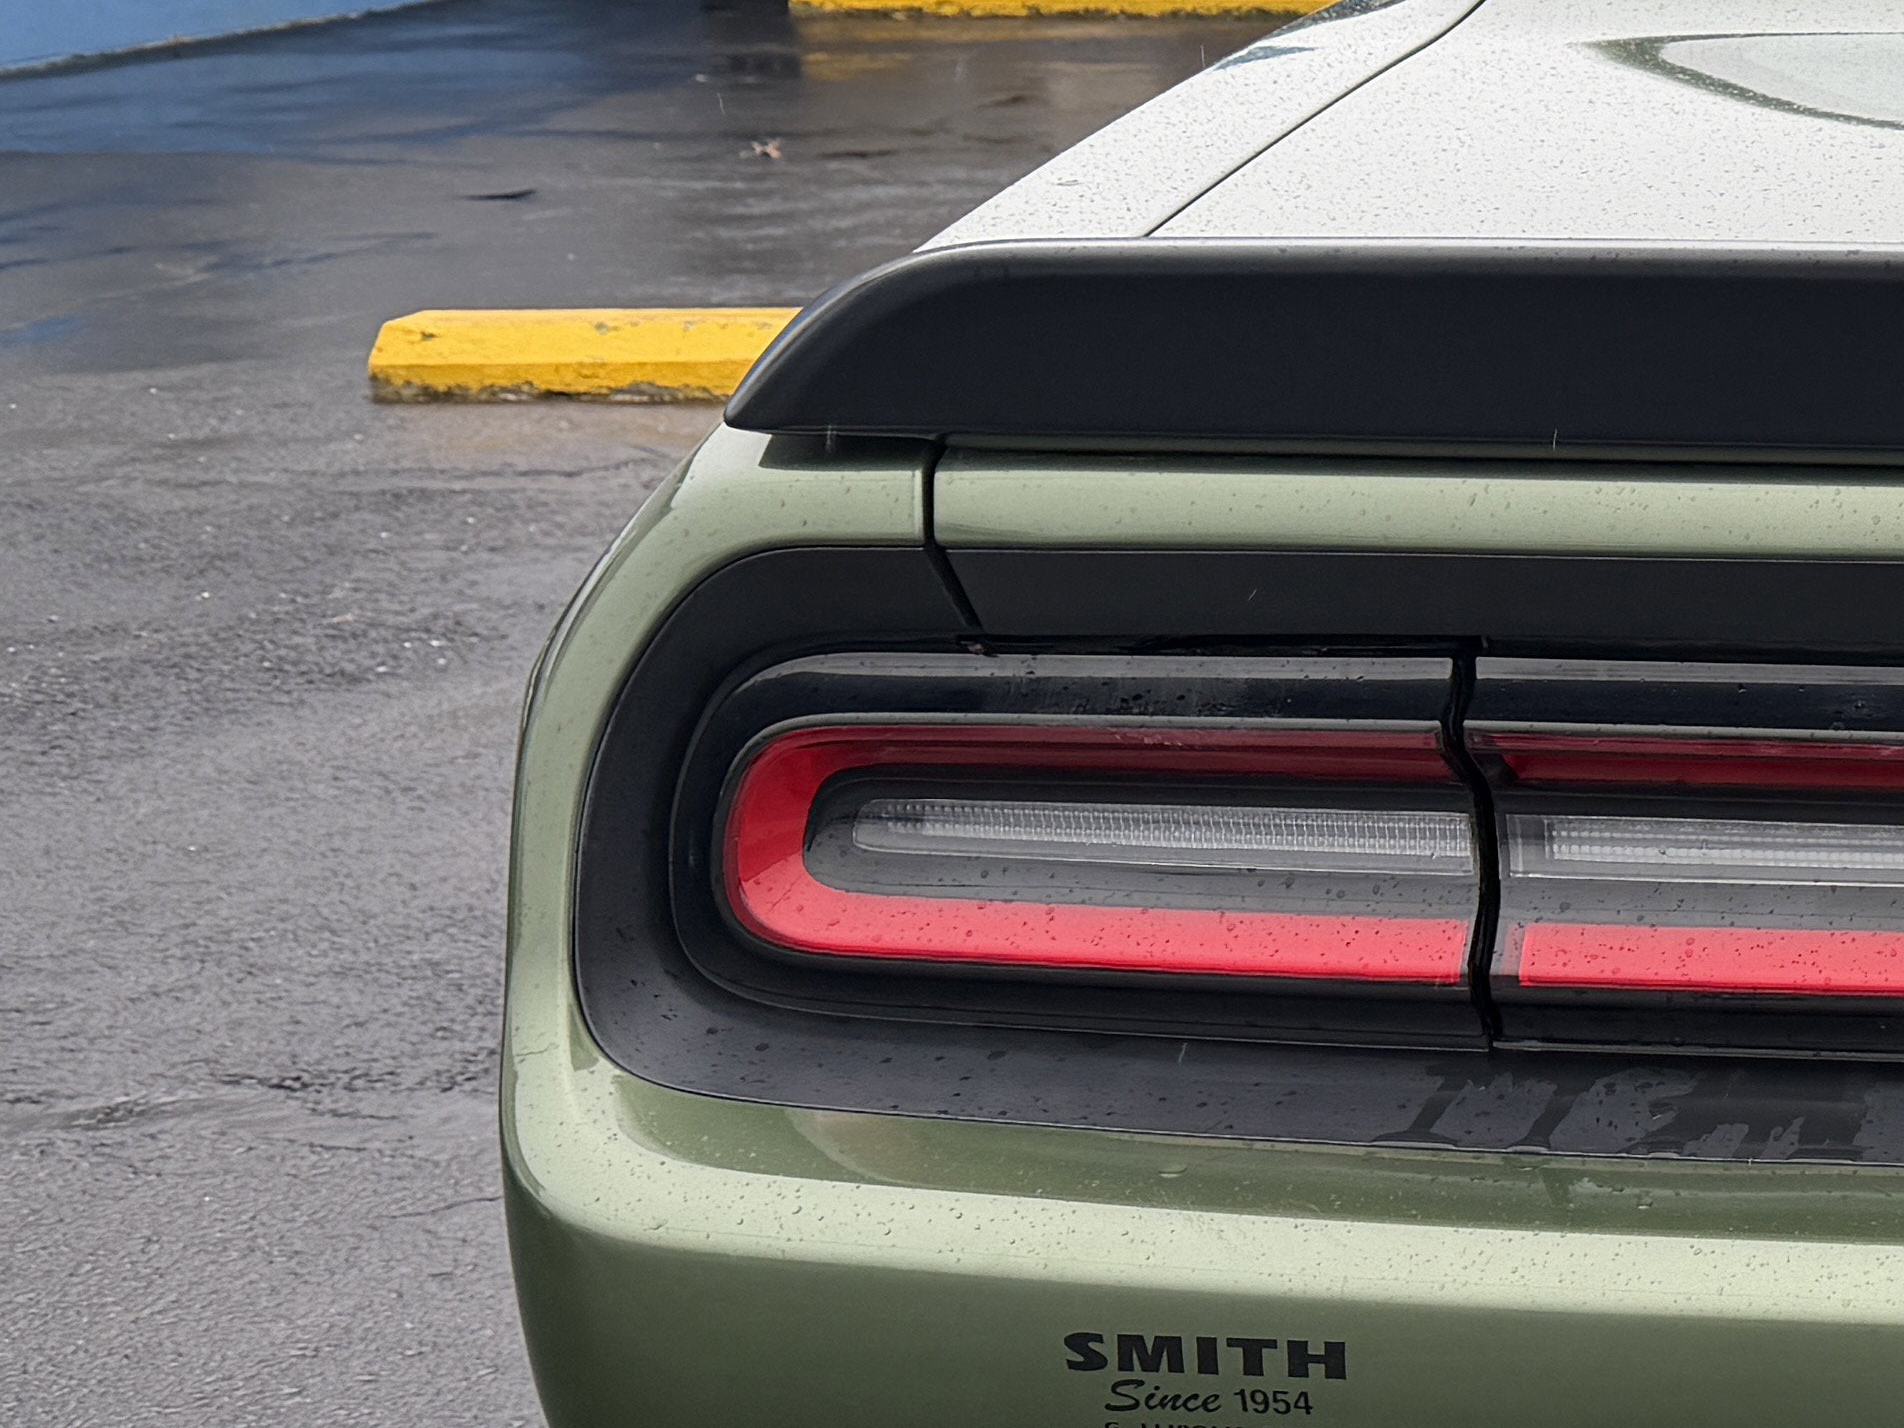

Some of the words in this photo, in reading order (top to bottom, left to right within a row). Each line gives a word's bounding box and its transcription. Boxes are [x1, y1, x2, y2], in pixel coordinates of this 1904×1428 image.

[1063, 1332, 1347, 1380] SMITH
[1104, 1378, 1221, 1412] Since
[1233, 1388, 1314, 1415] 1954
